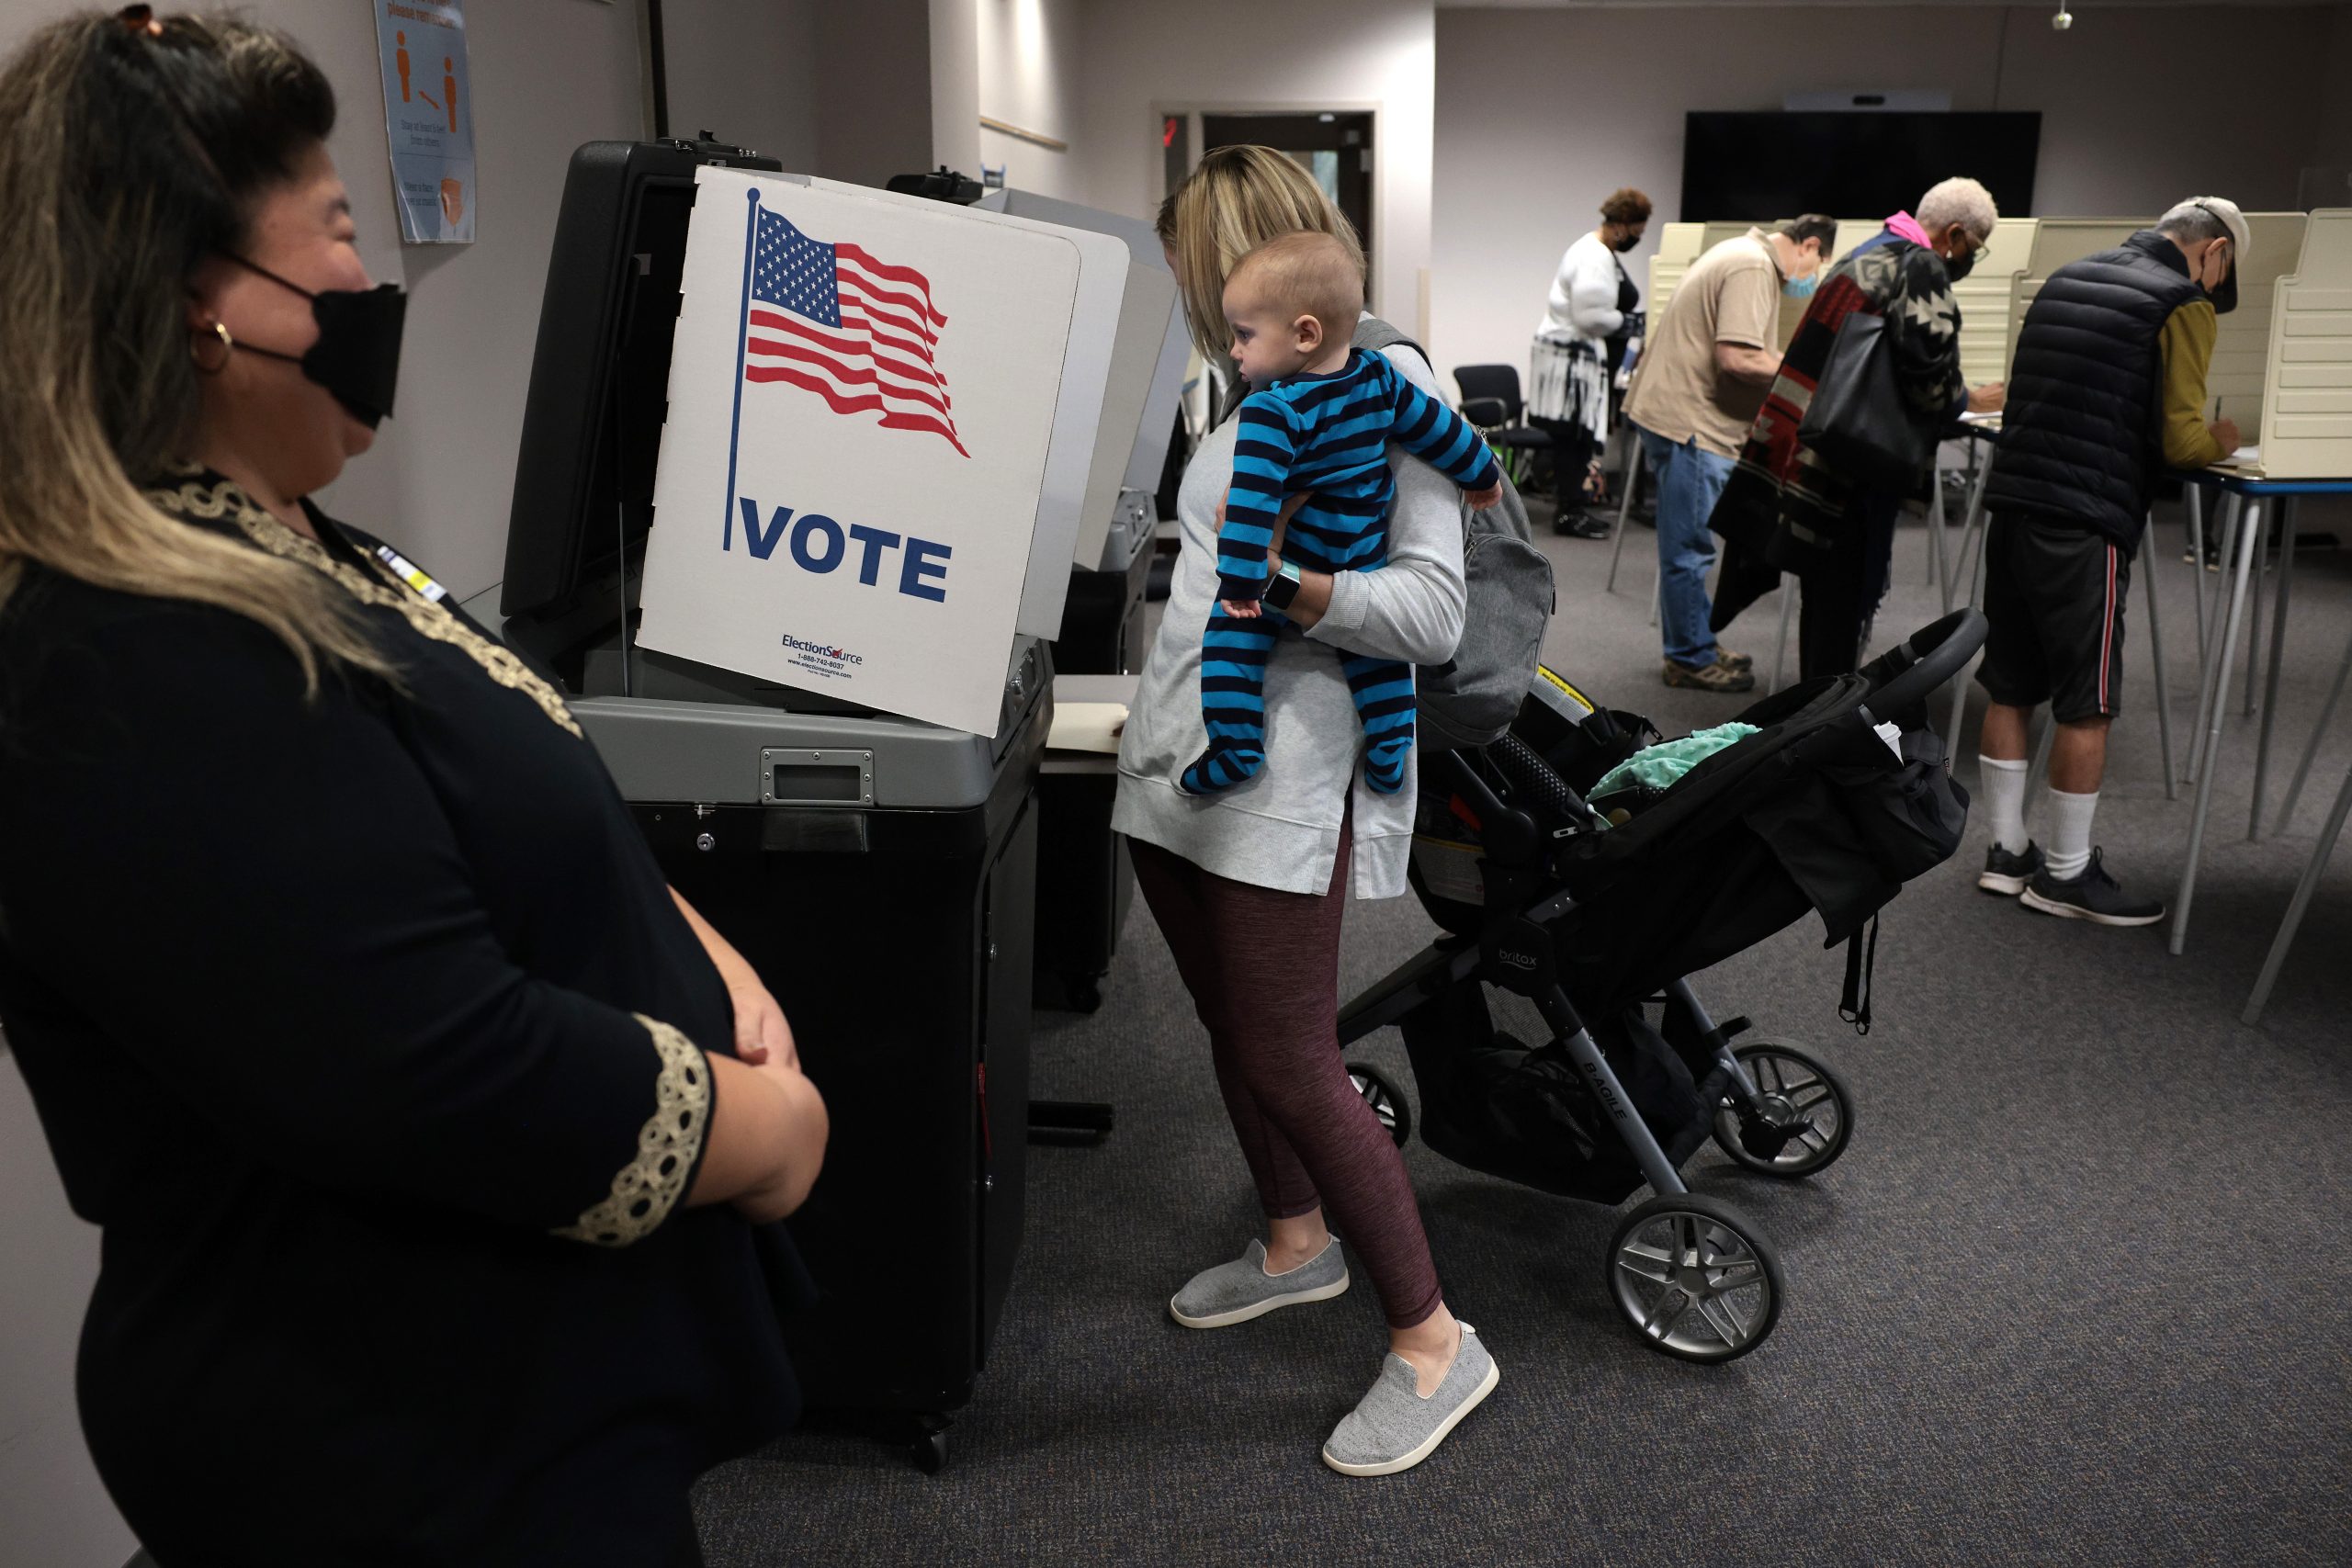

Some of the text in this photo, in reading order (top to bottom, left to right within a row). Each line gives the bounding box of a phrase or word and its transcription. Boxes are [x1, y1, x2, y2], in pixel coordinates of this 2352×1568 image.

[739, 496, 953, 604] VOTE
[782, 634, 863, 665] ElectionSource
[787, 659, 853, 679] www.electionsource.com
[797, 653, 844, 671] 1-888-742-8037
[1498, 948, 1537, 965] britax
